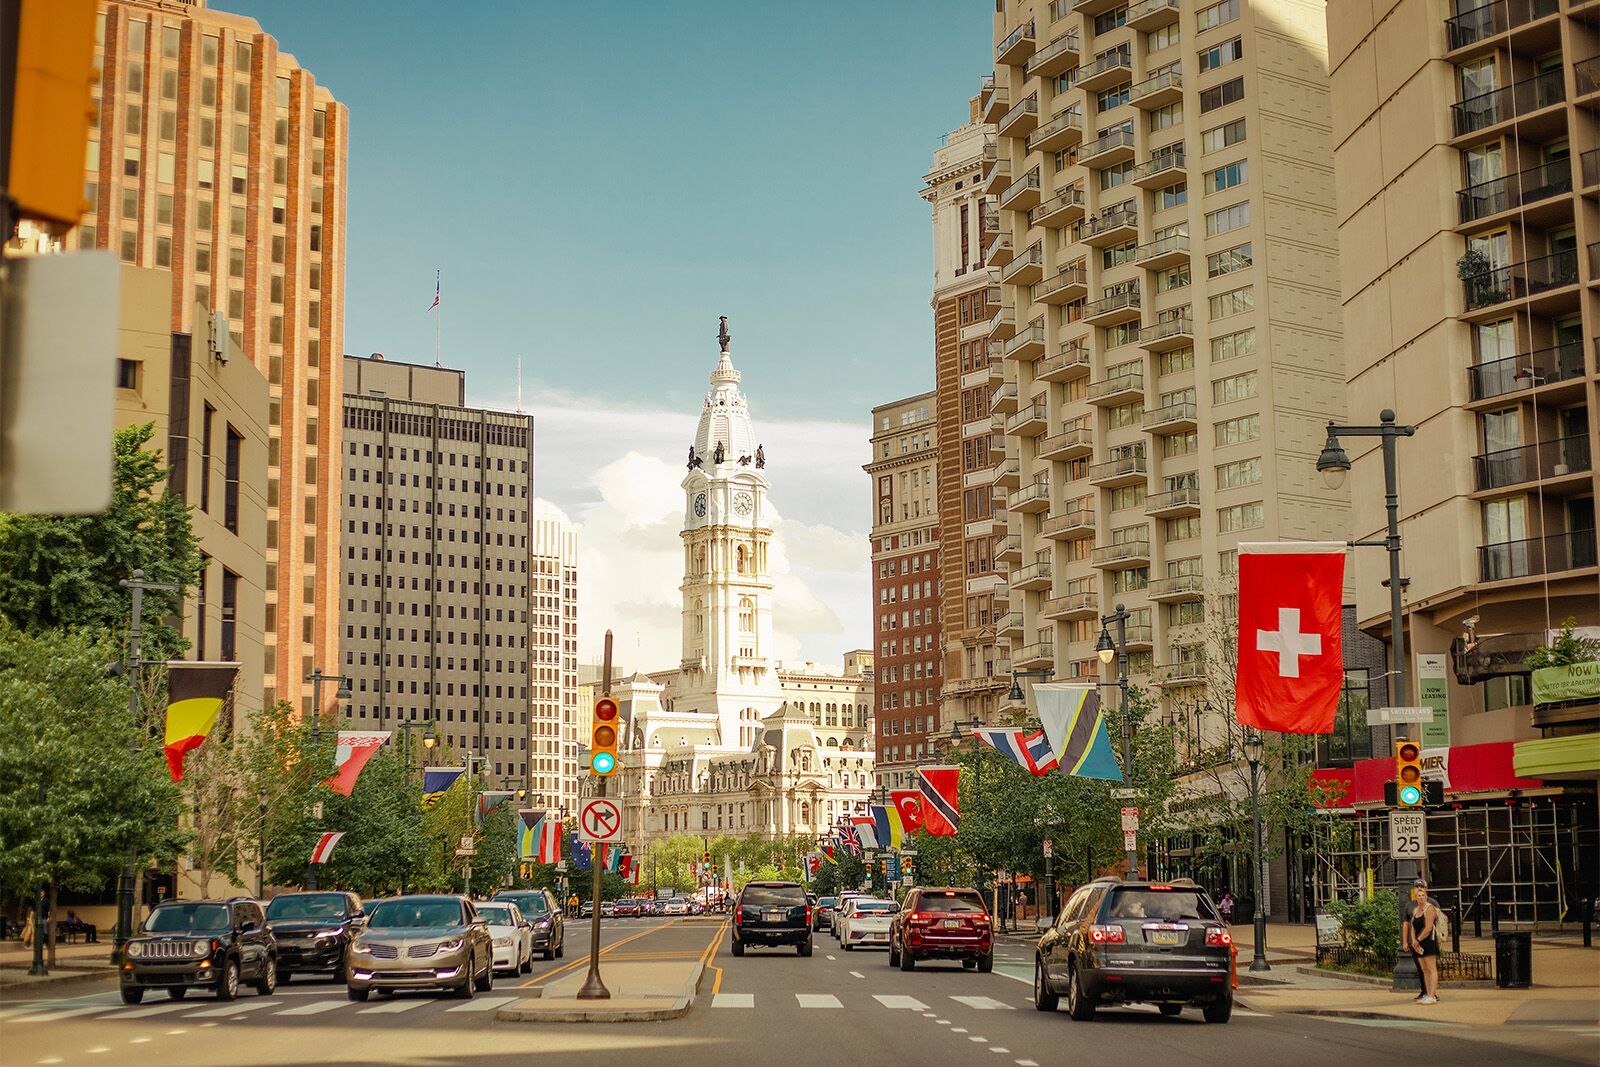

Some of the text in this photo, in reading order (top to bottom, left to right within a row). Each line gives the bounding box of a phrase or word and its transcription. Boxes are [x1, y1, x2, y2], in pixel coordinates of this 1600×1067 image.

[1568, 665, 1592, 677] NOW
[1394, 816, 1422, 825] SPEED
[1397, 826, 1419, 834] LIMIT
[1397, 836, 1420, 853] 25
